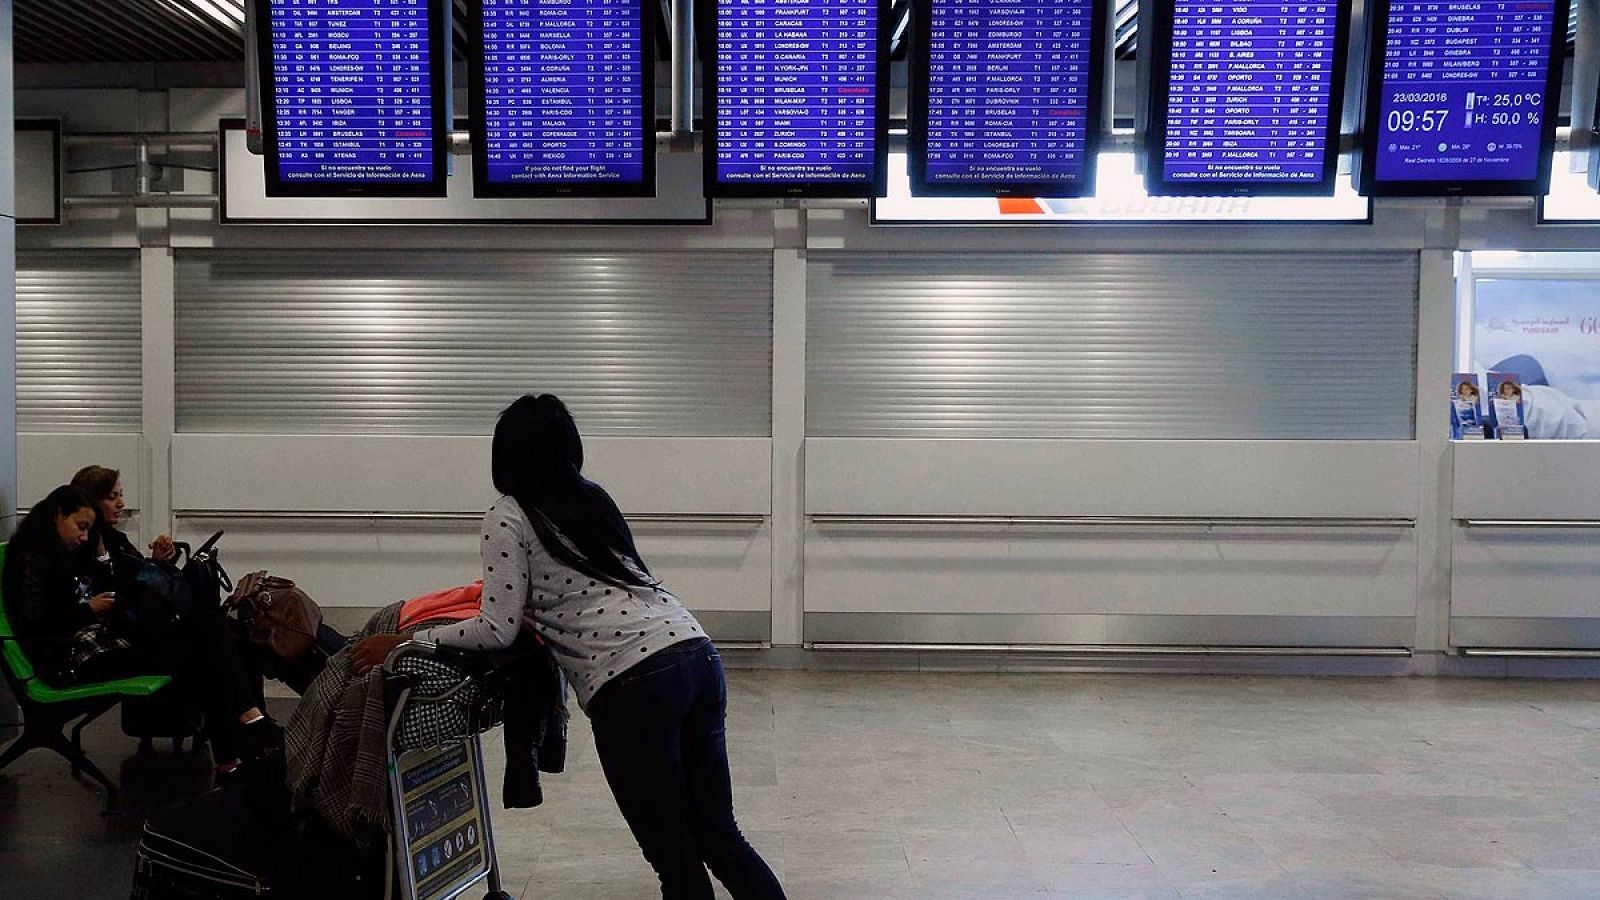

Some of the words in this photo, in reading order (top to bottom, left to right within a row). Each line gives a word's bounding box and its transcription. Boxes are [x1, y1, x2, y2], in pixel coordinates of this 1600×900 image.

[1393, 93, 1447, 102] 23/03/2016
[1493, 95, 1521, 106] 25,0
[1388, 110, 1448, 131] 09:57
[1475, 114, 1487, 123] H:
[1492, 113, 1520, 125] 50,0
[1528, 112, 1539, 124] %
